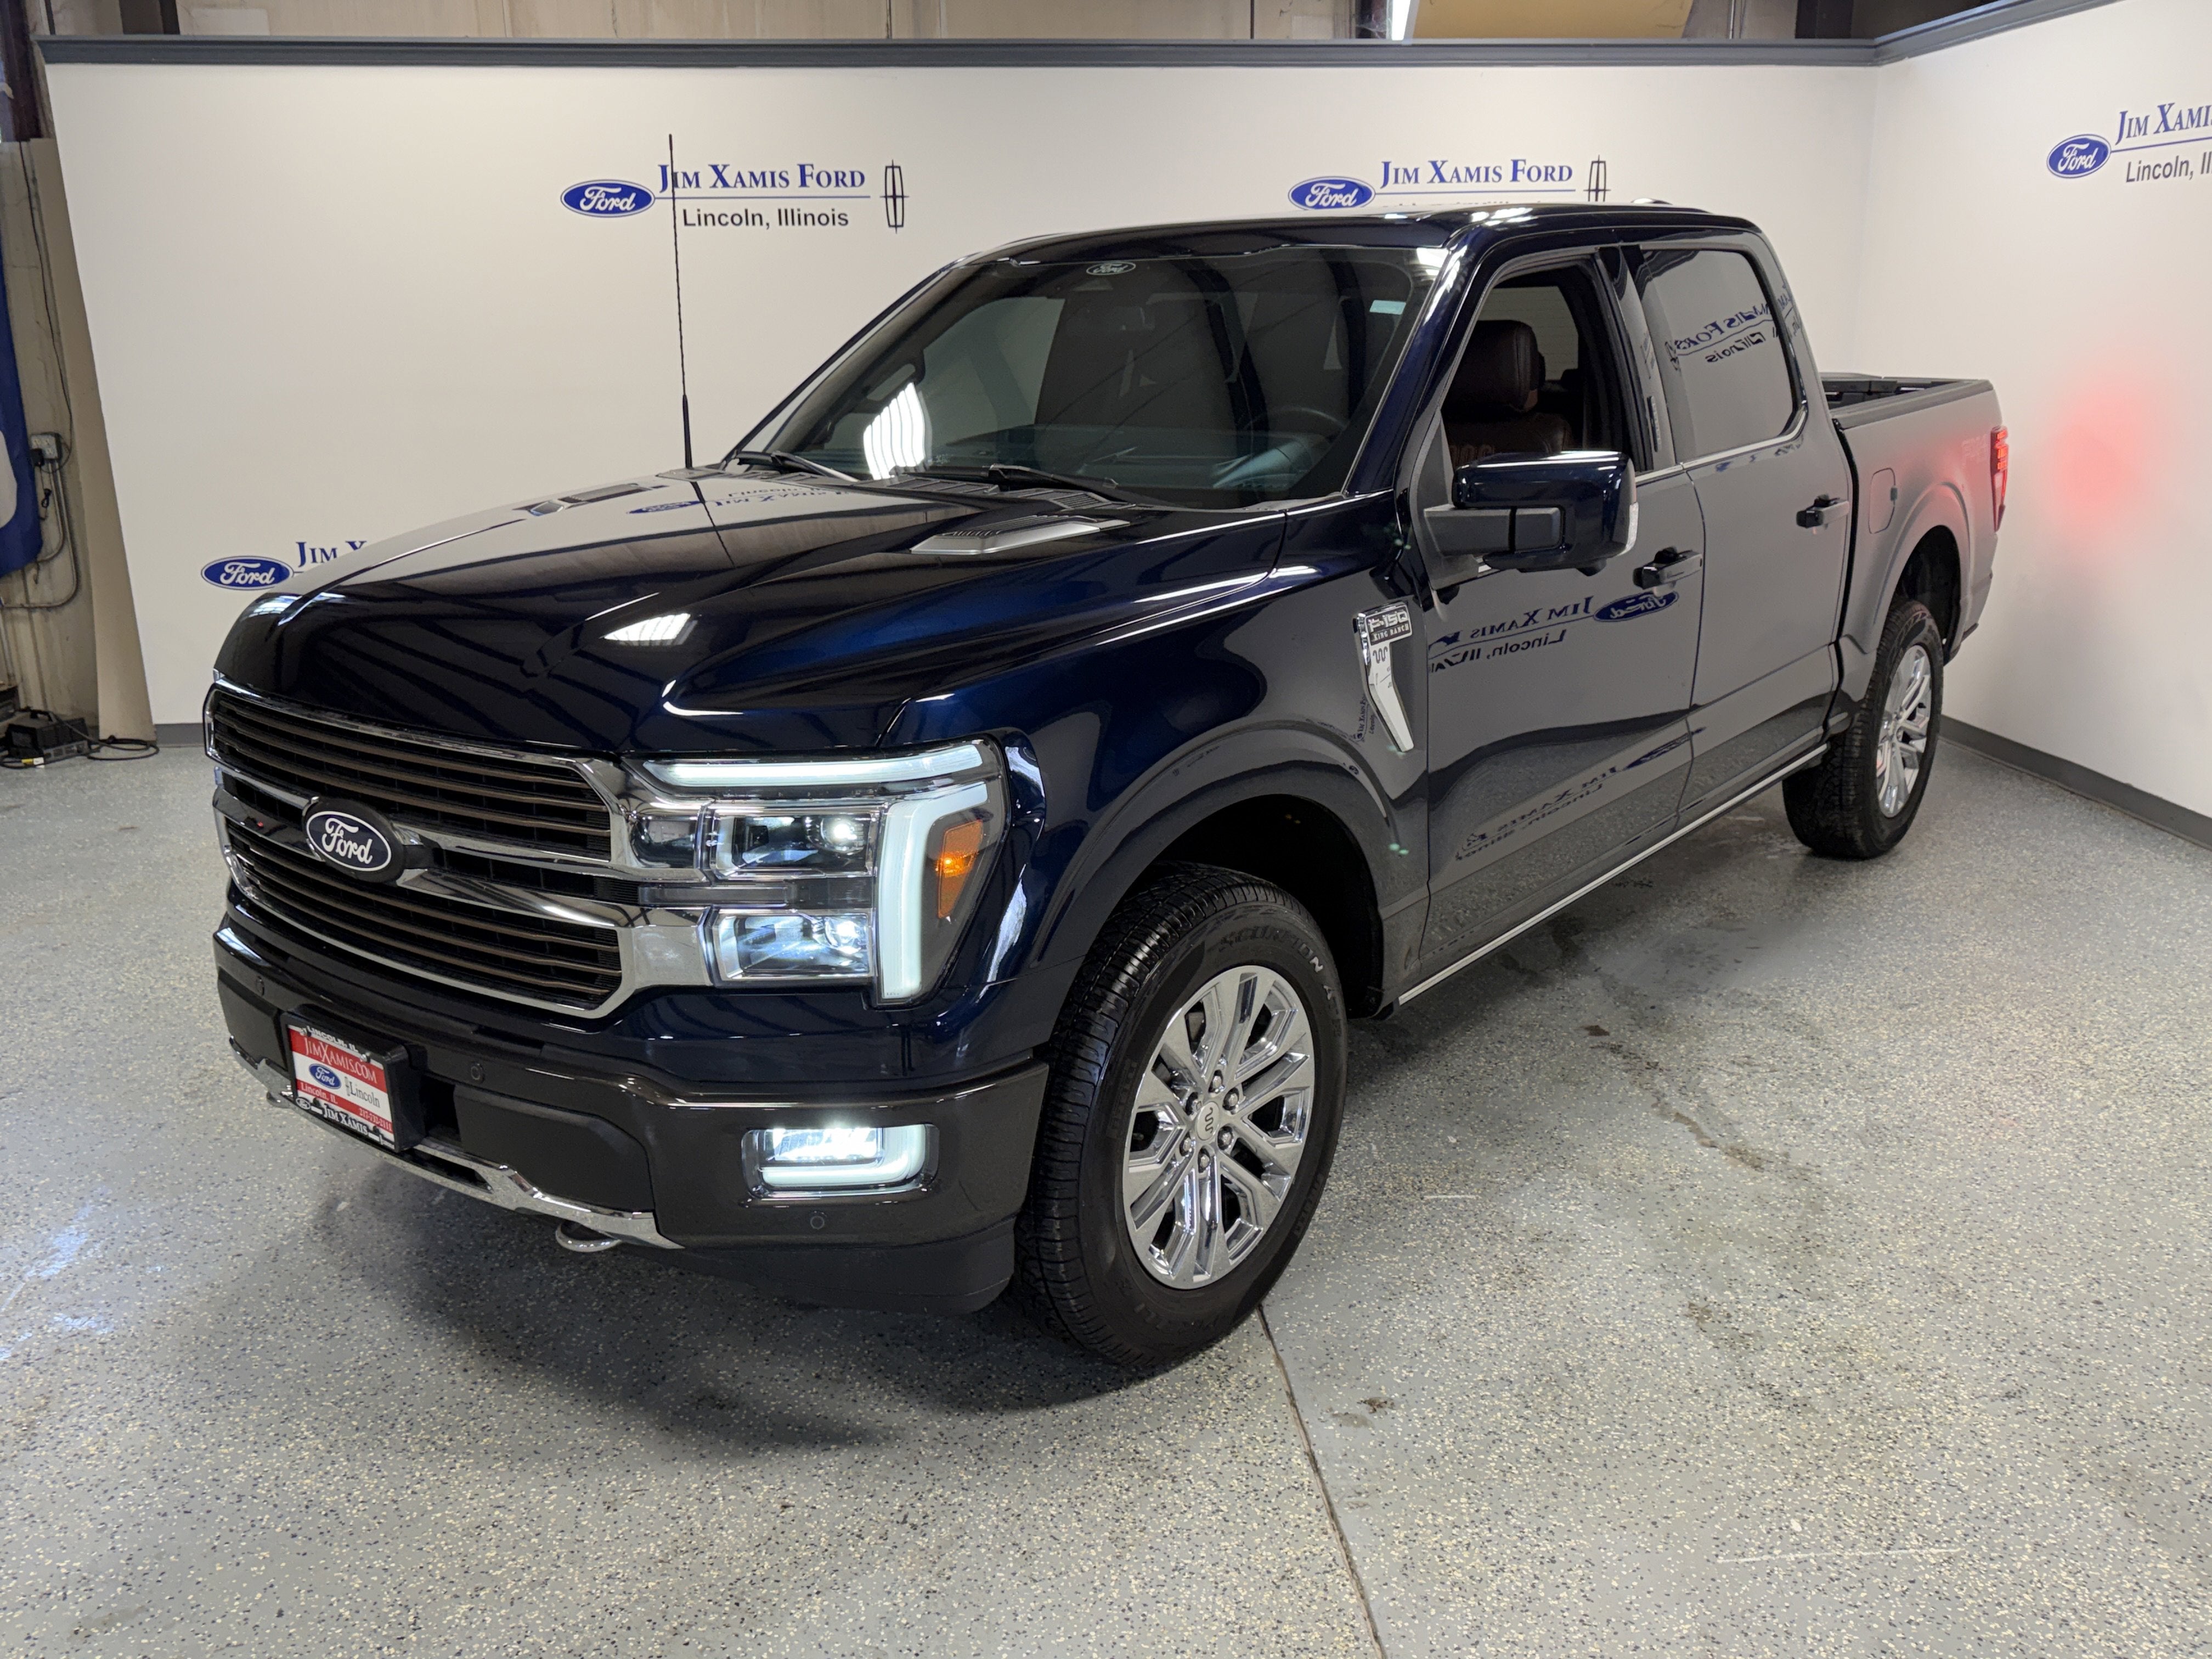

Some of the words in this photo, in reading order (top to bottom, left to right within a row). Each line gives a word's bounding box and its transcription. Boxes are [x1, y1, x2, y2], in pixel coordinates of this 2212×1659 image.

[2153, 103, 2212, 134] XAMI
[2058, 143, 2098, 172] Ford
[2126, 156, 2194, 182] Lincoln,
[579, 186, 635, 211] Ford
[1305, 183, 1357, 207] Ford
[683, 208, 770, 229] Lincoln,
[778, 208, 849, 227] Illinois
[1093, 263, 1128, 273] Ford
[220, 562, 275, 585] Ford
[1368, 611, 1408, 633] F-150
[1373, 631, 1388, 641] KING
[1390, 623, 1409, 635] RANCH
[322, 817, 373, 864] Ford
[316, 1066, 335, 1086] Ford
[330, 1094, 338, 1104] IL
[349, 1081, 380, 1108] Lincoln
